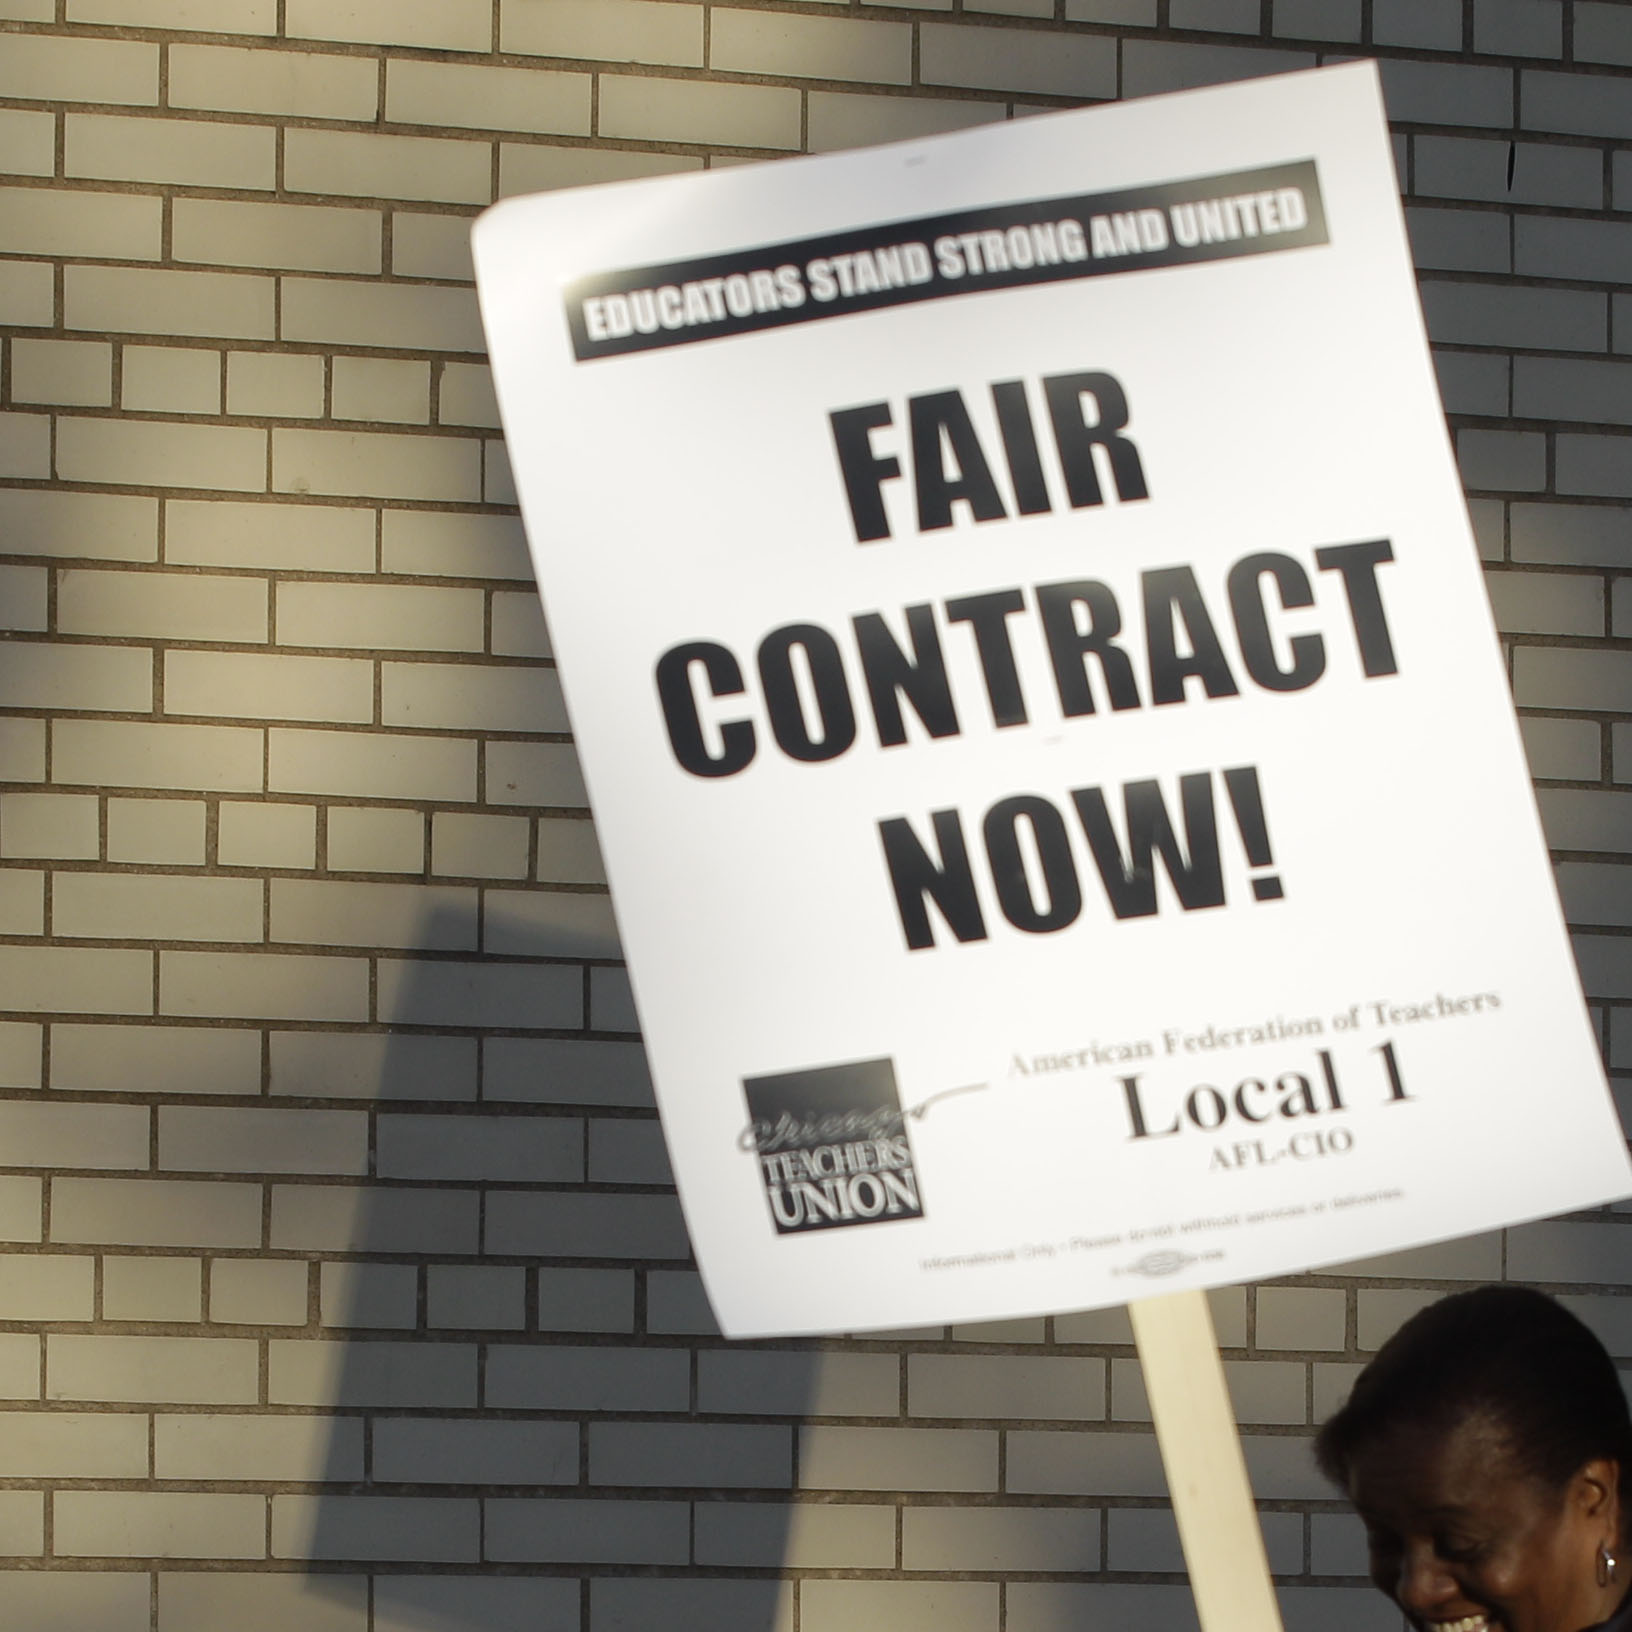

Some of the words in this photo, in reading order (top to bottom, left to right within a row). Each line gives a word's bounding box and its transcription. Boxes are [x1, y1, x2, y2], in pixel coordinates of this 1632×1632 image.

[582, 262, 806, 343] EDUCATORS
[806, 240, 932, 304] STAND
[934, 217, 1087, 286] STRONG
[1090, 206, 1170, 260] AND
[1169, 187, 1309, 248] UNITED
[827, 368, 1152, 545] FAIR
[653, 538, 1401, 782] CONTRACT
[876, 764, 1288, 953] NOW!
[1008, 1034, 1155, 1080] American
[1163, 1013, 1325, 1058] Federation
[1333, 1003, 1362, 1033] of
[1371, 987, 1502, 1031] Teachers
[1116, 1047, 1347, 1141] Local
[1370, 1037, 1417, 1105] 1
[762, 1135, 912, 1183] TEACHERS
[769, 1167, 920, 1228] UNION
[1208, 1125, 1355, 1172] AFL-CIO
